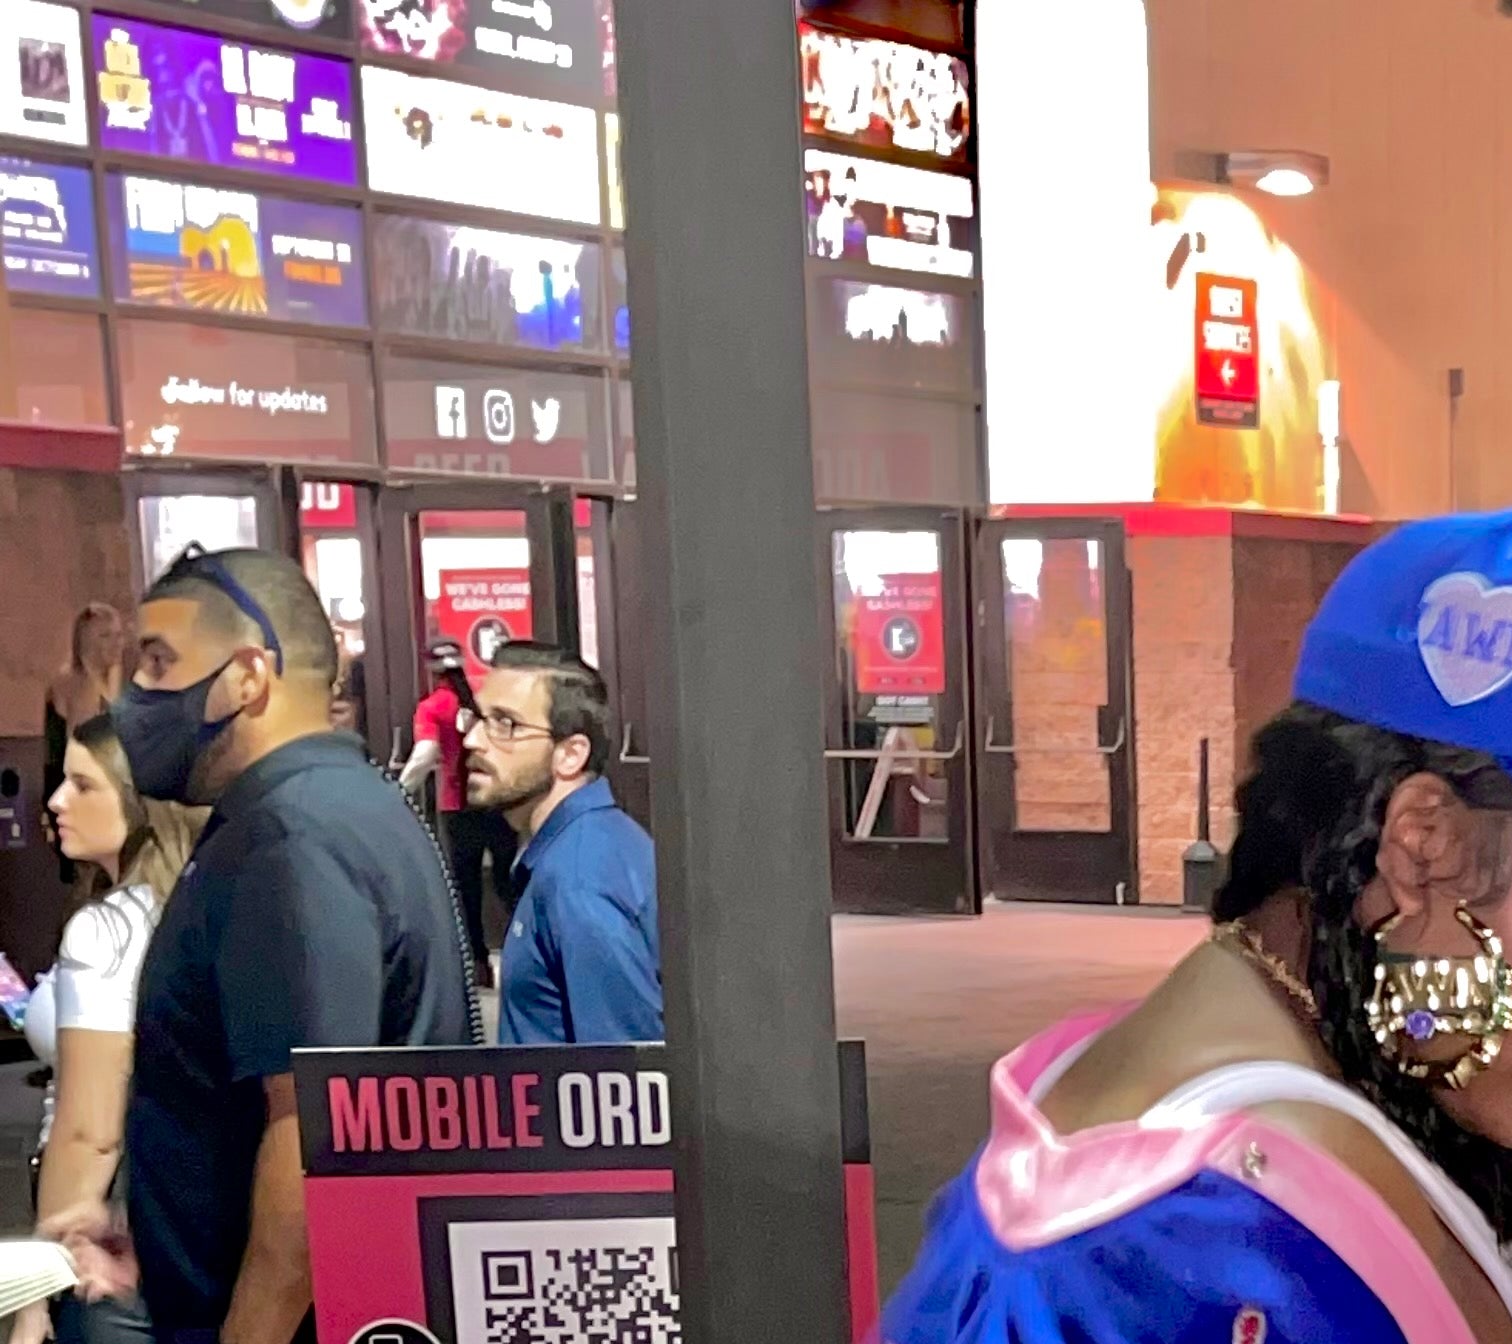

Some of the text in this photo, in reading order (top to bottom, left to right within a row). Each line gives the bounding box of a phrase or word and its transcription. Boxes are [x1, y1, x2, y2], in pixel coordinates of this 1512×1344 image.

[229, 381, 254, 406] for
[258, 386, 327, 415] updates
[327, 1071, 671, 1152] MOBILE ORD
